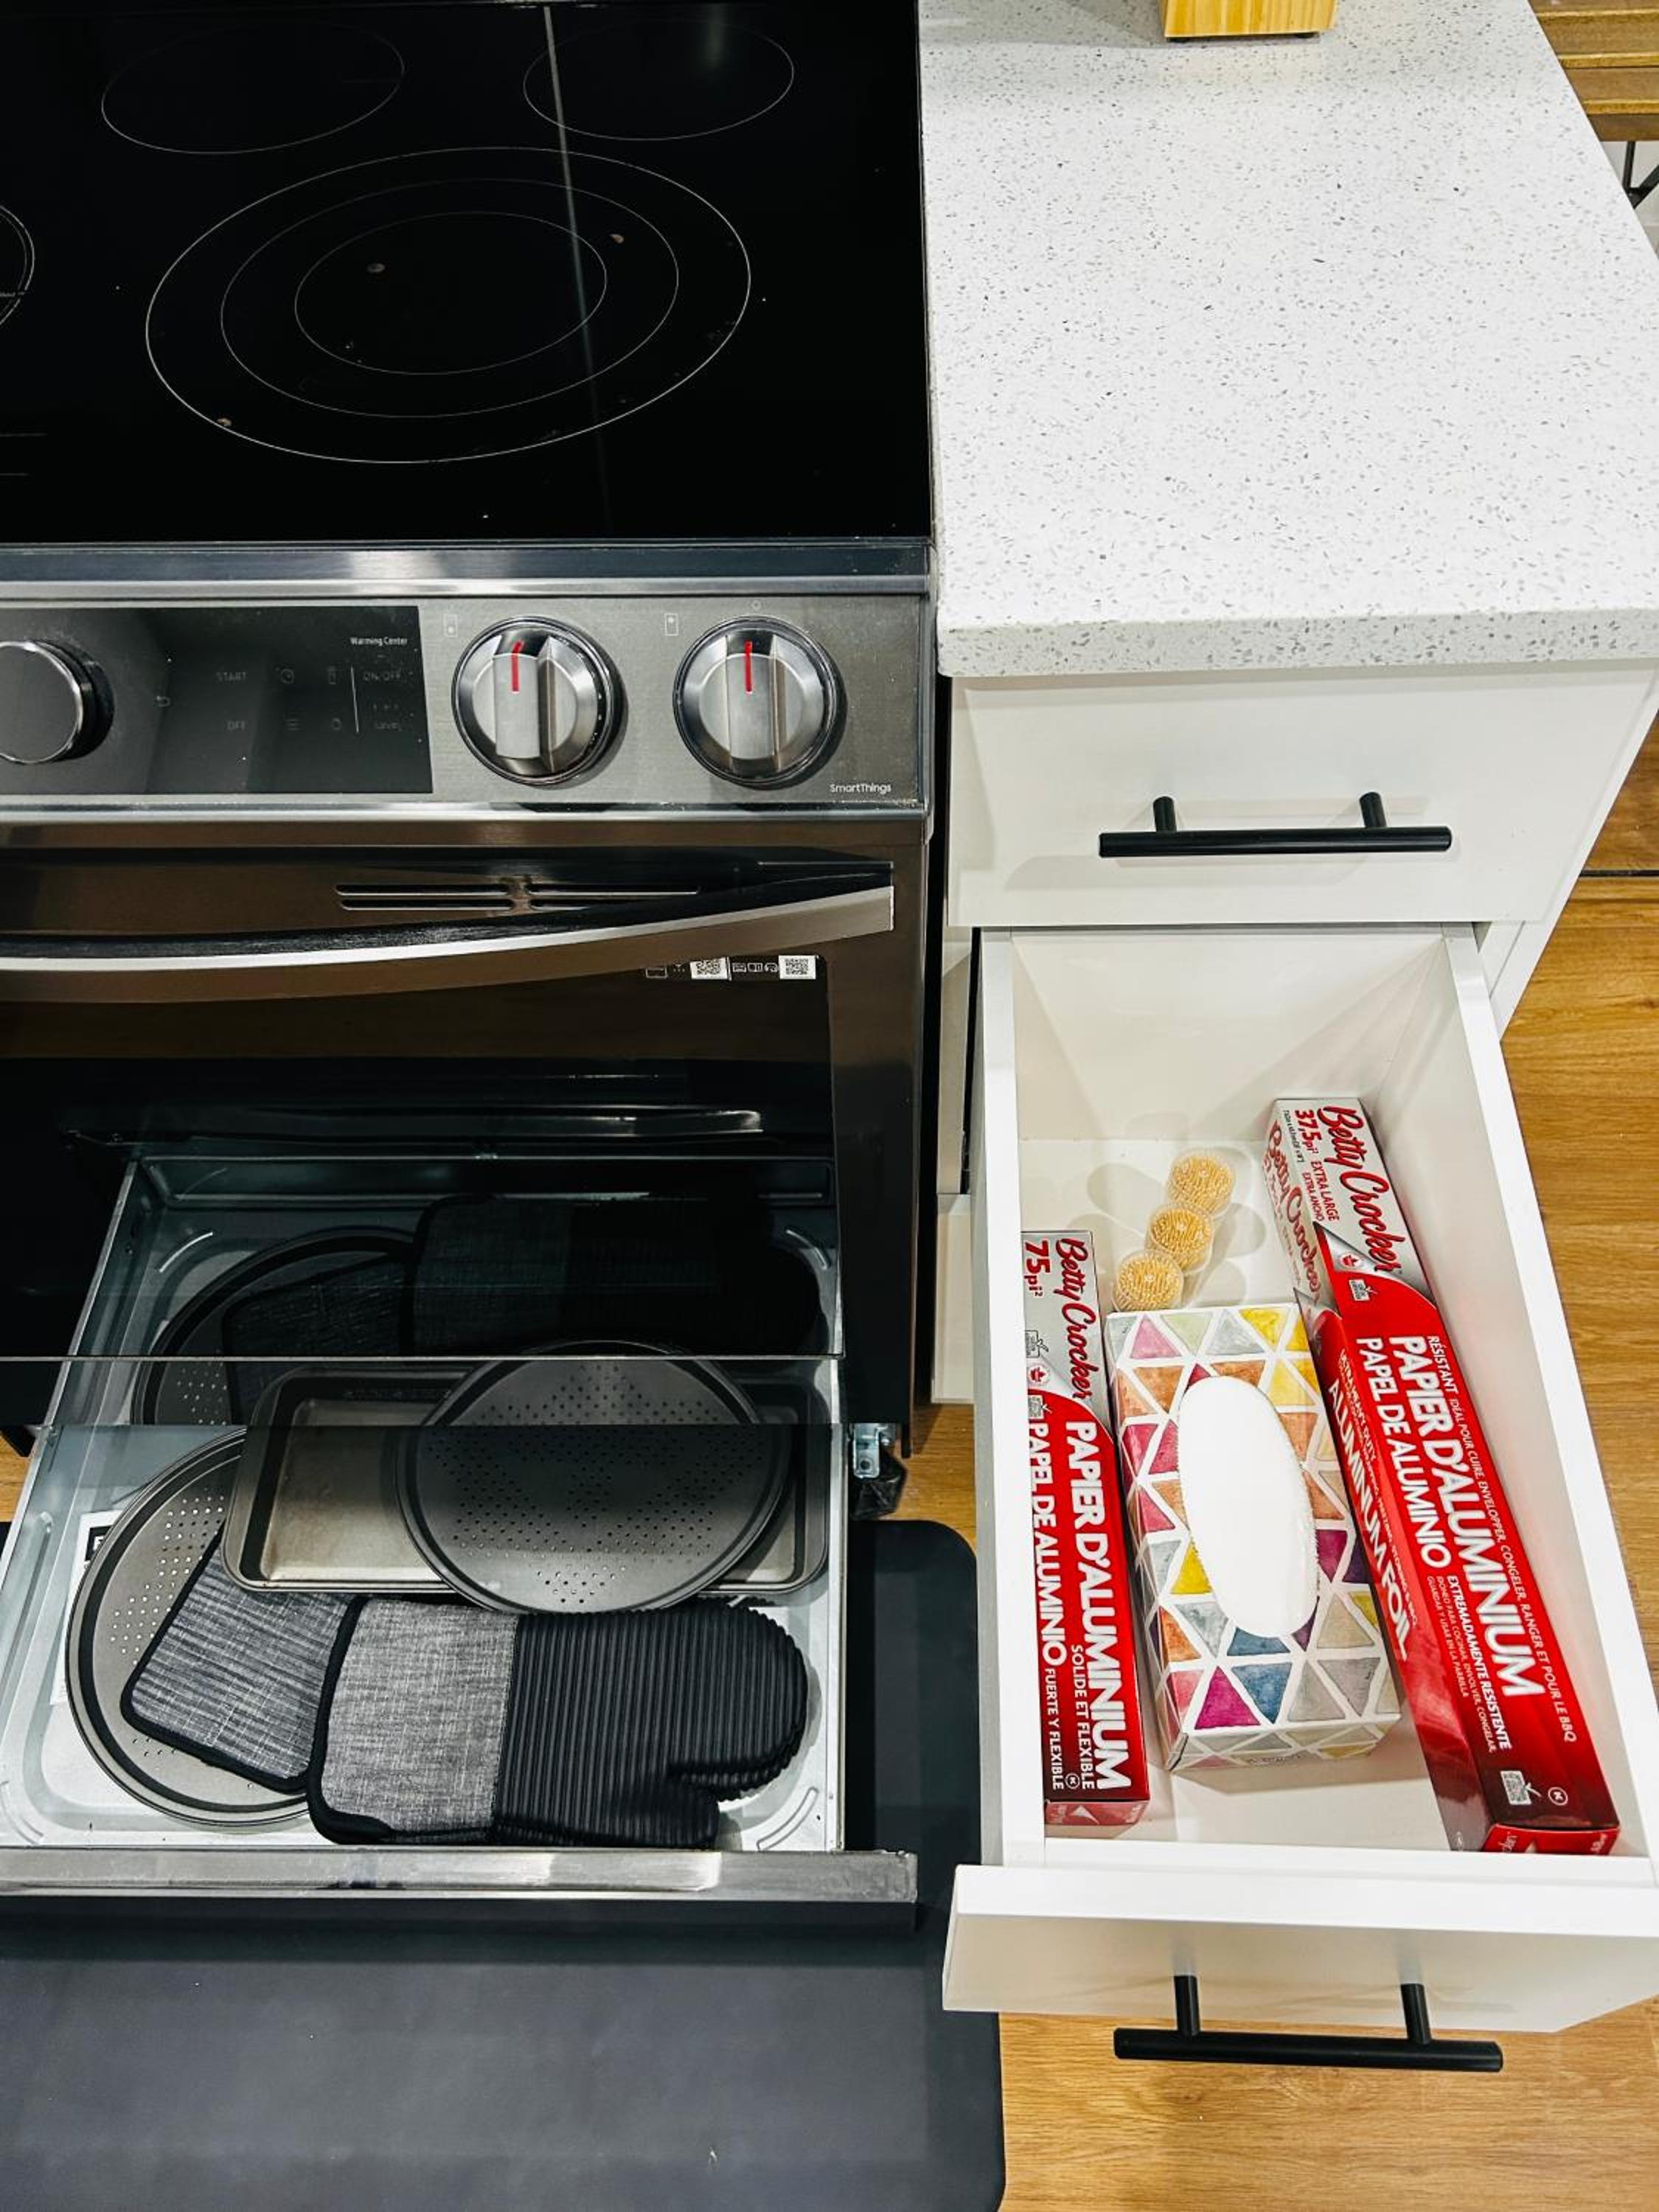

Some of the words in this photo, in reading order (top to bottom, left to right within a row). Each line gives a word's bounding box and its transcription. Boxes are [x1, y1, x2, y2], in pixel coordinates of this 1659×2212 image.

[350, 637, 383, 647] Warming
[384, 636, 408, 645] Center
[830, 782, 891, 795] SmartThings
[1317, 1105, 1367, 1169] Betty
[1310, 1160, 1329, 1190] EXTRA
[1321, 1190, 1340, 1222] LARGE
[1340, 1171, 1406, 1272] Crocker
[1054, 1238, 1089, 1301] Betty
[1062, 1303, 1099, 1399] Crocker
[1356, 1338, 1399, 1402] PAPEL
[1427, 1335, 1459, 1394] RÉSISTANT
[1377, 1404, 1412, 1436] DE
[1458, 1424, 1475, 1450] POUR
[1029, 1422, 1054, 1492] PAPEL
[1065, 1421, 1105, 1530] PAPIER
[1032, 1495, 1057, 1528] DE
[1329, 1378, 1387, 1573] ALUMINUM
[1382, 1559, 1410, 1661] FOIL
[1386, 1439, 1452, 1568] ALUMINIO
[1389, 1335, 1454, 1436] PAPIER
[1423, 1439, 1545, 1696] D'ALUMINIUM
[1034, 1531, 1068, 1666] ALUMINIO
[1520, 1603, 1543, 1651] RANGER
[1071, 1644, 1088, 1698] SOLIDE
[1076, 1533, 1132, 1790] D'ALUMINIUM
[1447, 1575, 1489, 1680] EXTREMADAMENTE
[1480, 1680, 1513, 1751] RESISTENTE
[1537, 1650, 1551, 1664] ET
[1543, 1665, 1562, 1700] POUR
[1045, 1668, 1060, 1717] FUERTE
[1075, 1700, 1089, 1719] ET
[1553, 1700, 1568, 1715] LE
[1048, 1718, 1060, 1728] Y
[1559, 1716, 1577, 1742] BBQ
[1048, 1731, 1065, 1790] FLEXIBLE
[1077, 1722, 1095, 1790] FLEXIBLE
